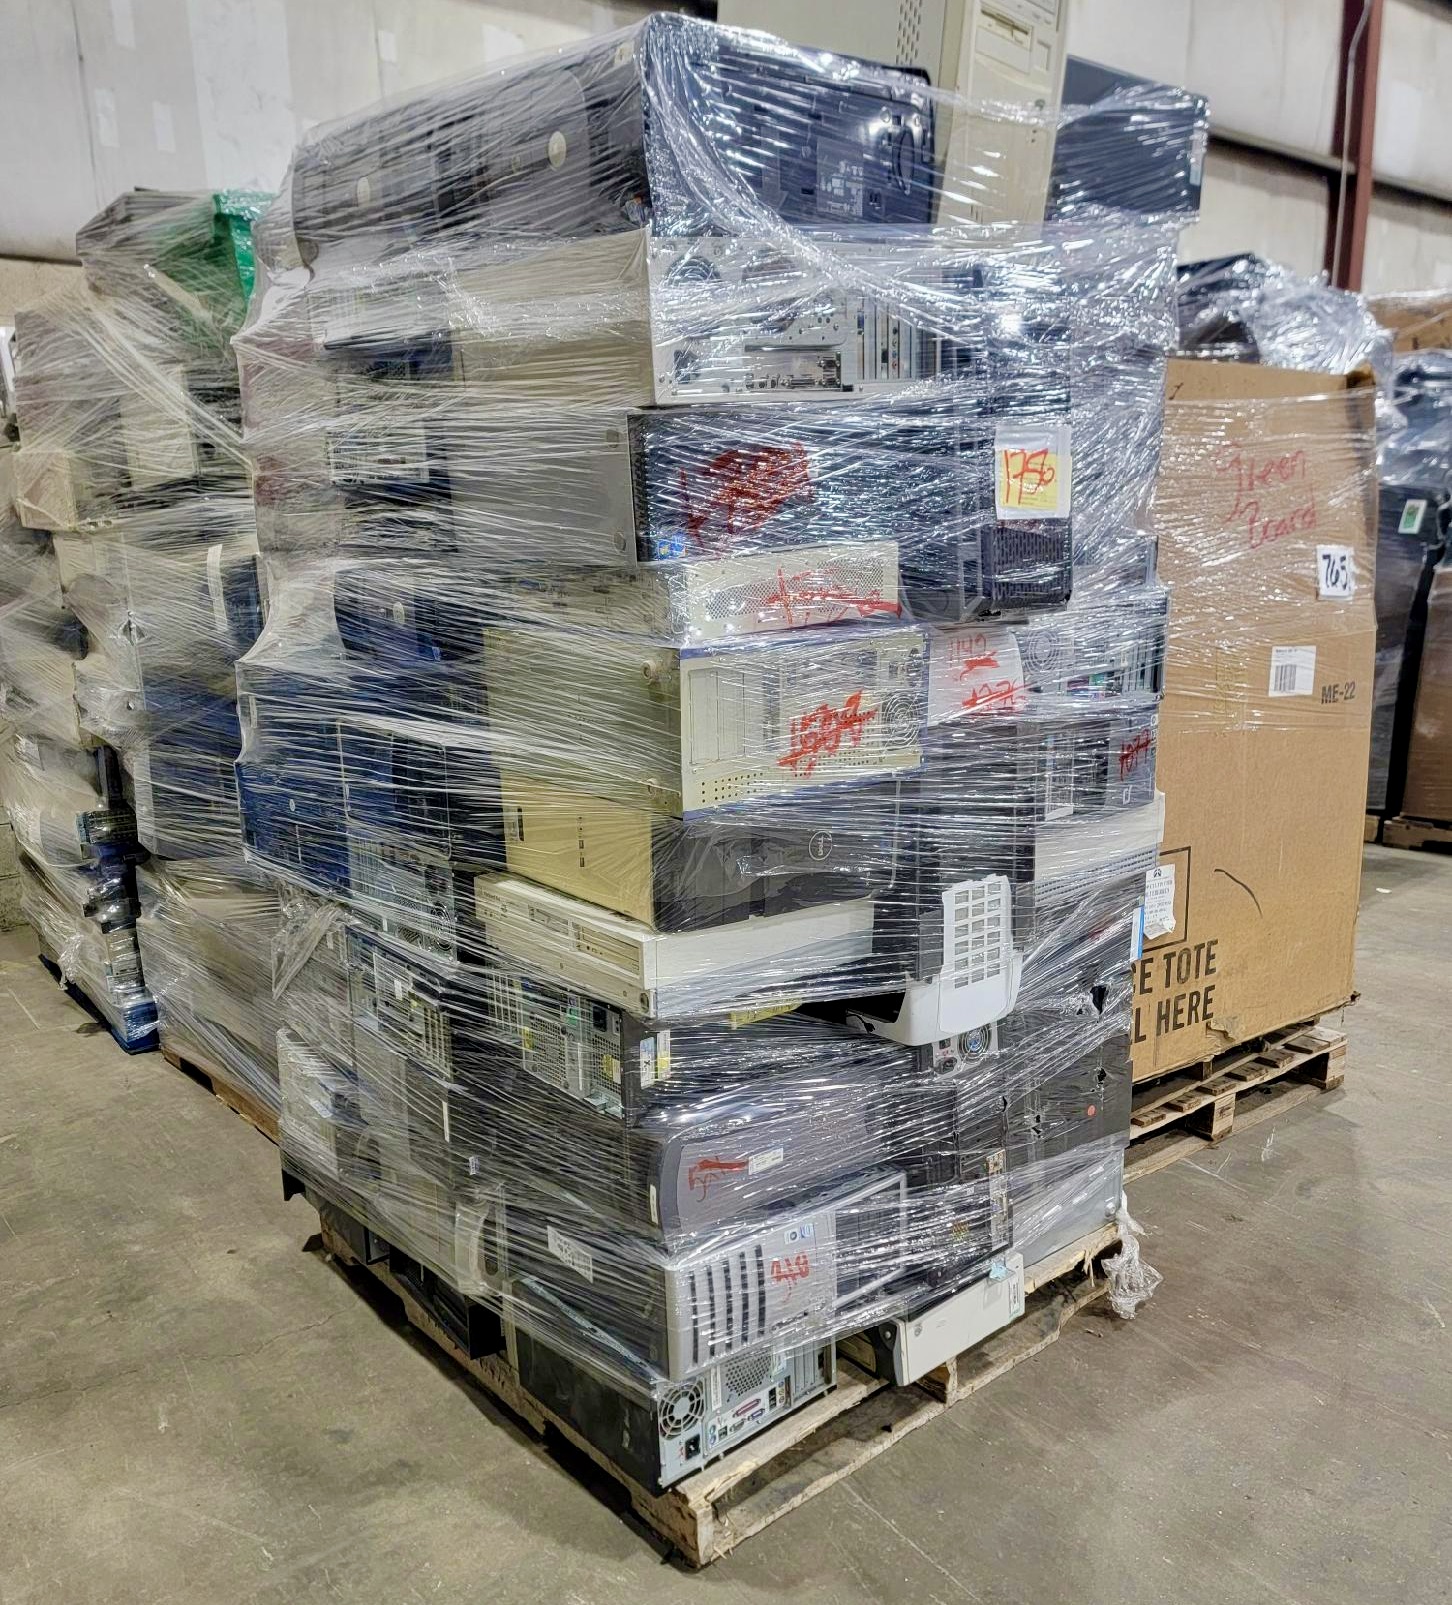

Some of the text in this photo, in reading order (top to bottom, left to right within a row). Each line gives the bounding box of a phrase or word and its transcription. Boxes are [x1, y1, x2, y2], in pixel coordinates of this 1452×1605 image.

[1322, 554, 1348, 591] 765
[1321, 681, 1356, 704] ME-22
[1162, 938, 1218, 989] TOTE
[1156, 984, 1216, 1036] HERE
